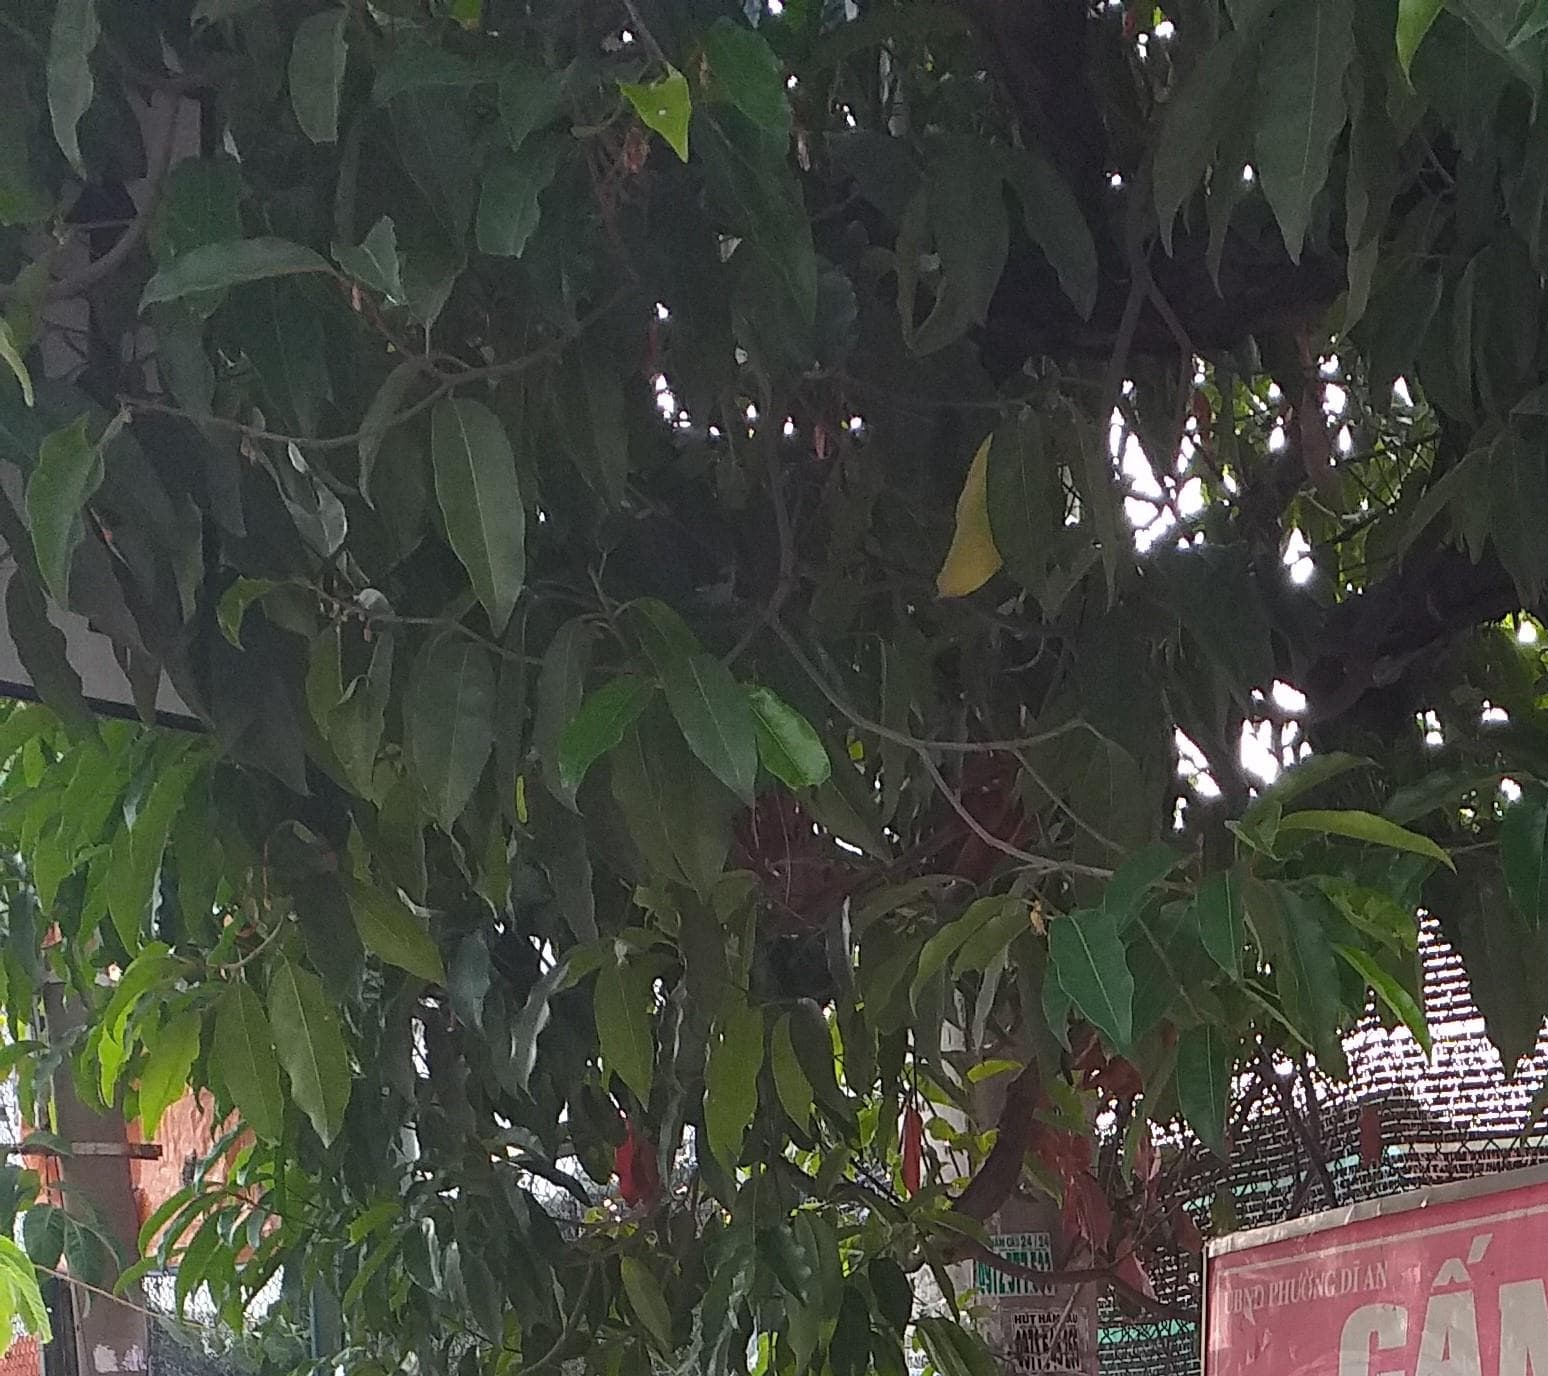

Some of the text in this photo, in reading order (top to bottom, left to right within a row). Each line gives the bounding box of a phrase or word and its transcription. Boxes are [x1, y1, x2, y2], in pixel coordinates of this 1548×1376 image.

[1224, 1261, 1389, 1315] UBND PHƯỜNG DĨ AN
